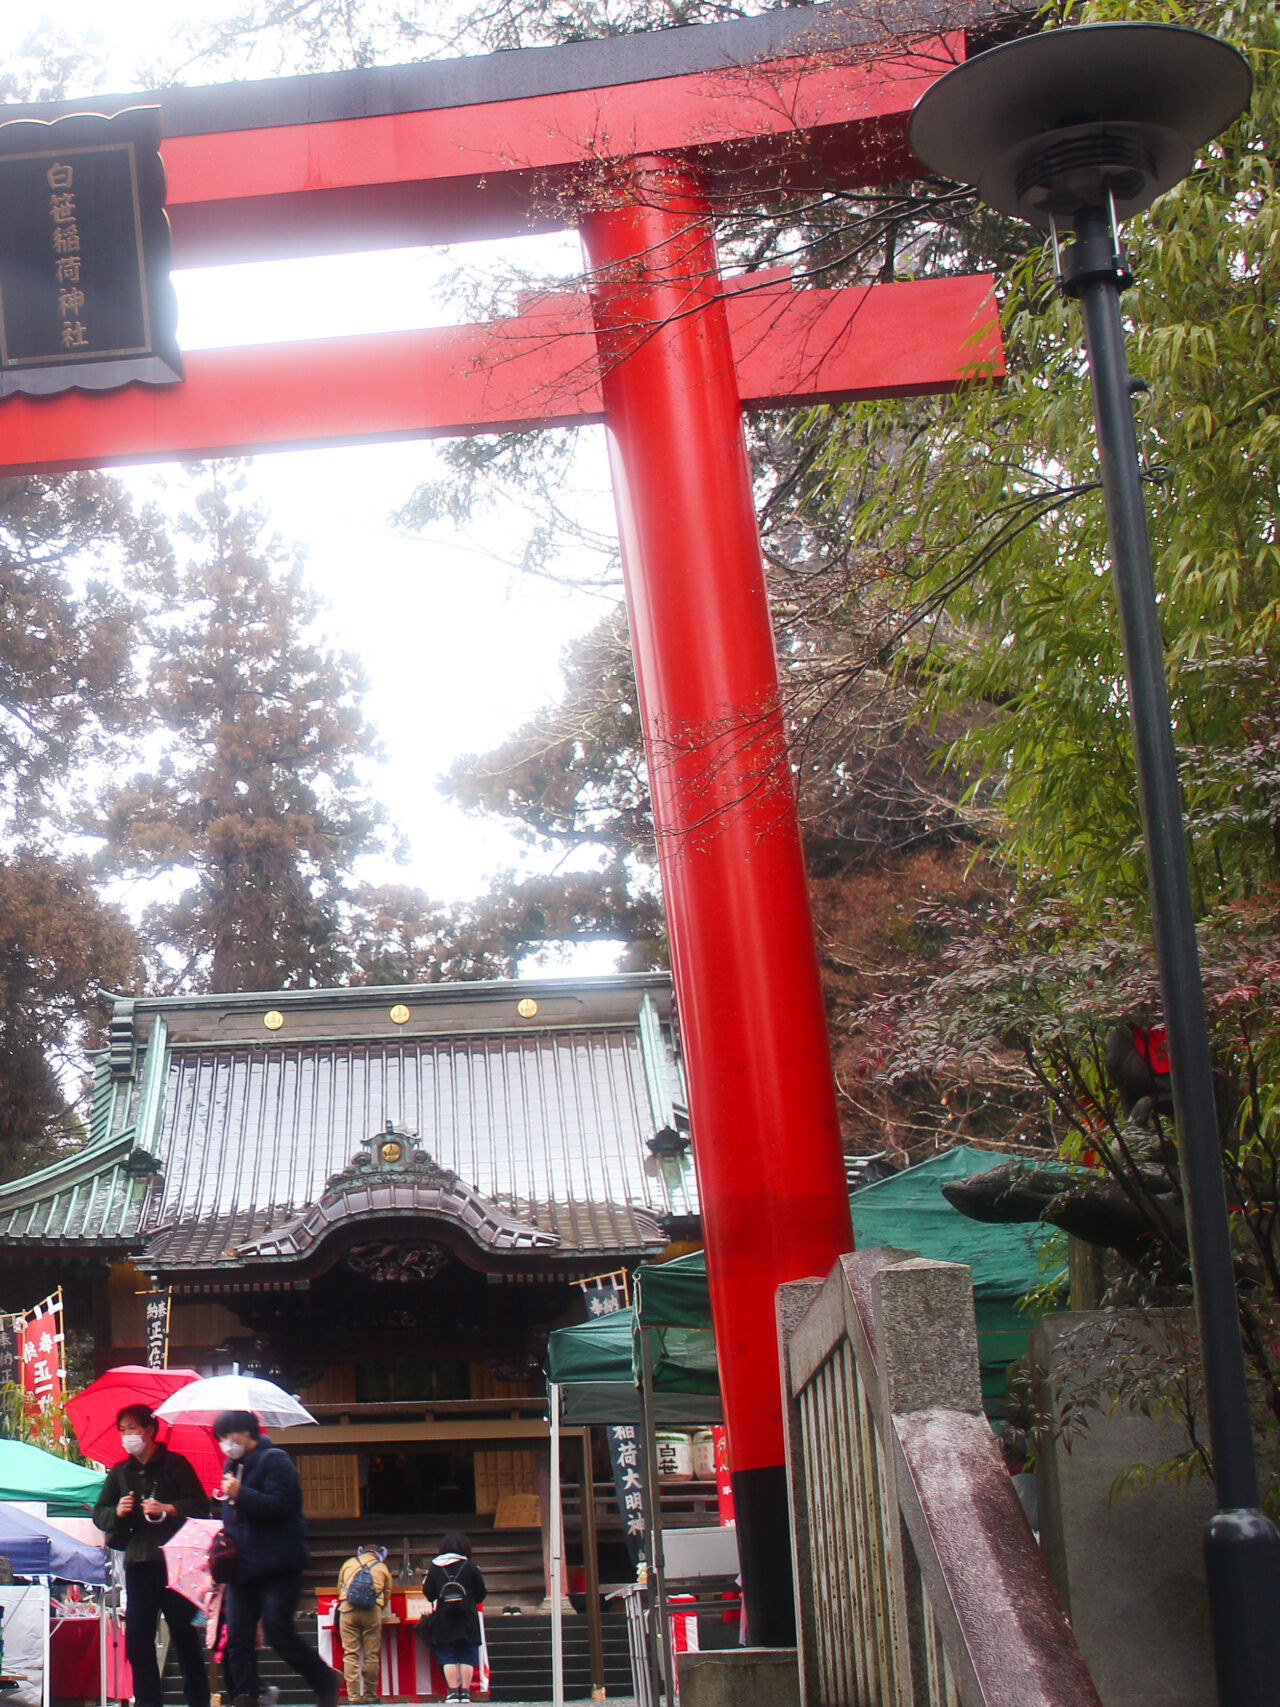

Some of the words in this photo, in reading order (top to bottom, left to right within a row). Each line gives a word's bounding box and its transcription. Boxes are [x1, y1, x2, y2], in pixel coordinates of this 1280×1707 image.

[46, 162, 88, 348] 白笹稲荷神社
[146, 1300, 167, 1320] 奉納
[590, 1295, 619, 1316] 奉納
[148, 1320, 165, 1369] 正一位
[658, 1443, 679, 1475] 白笹
